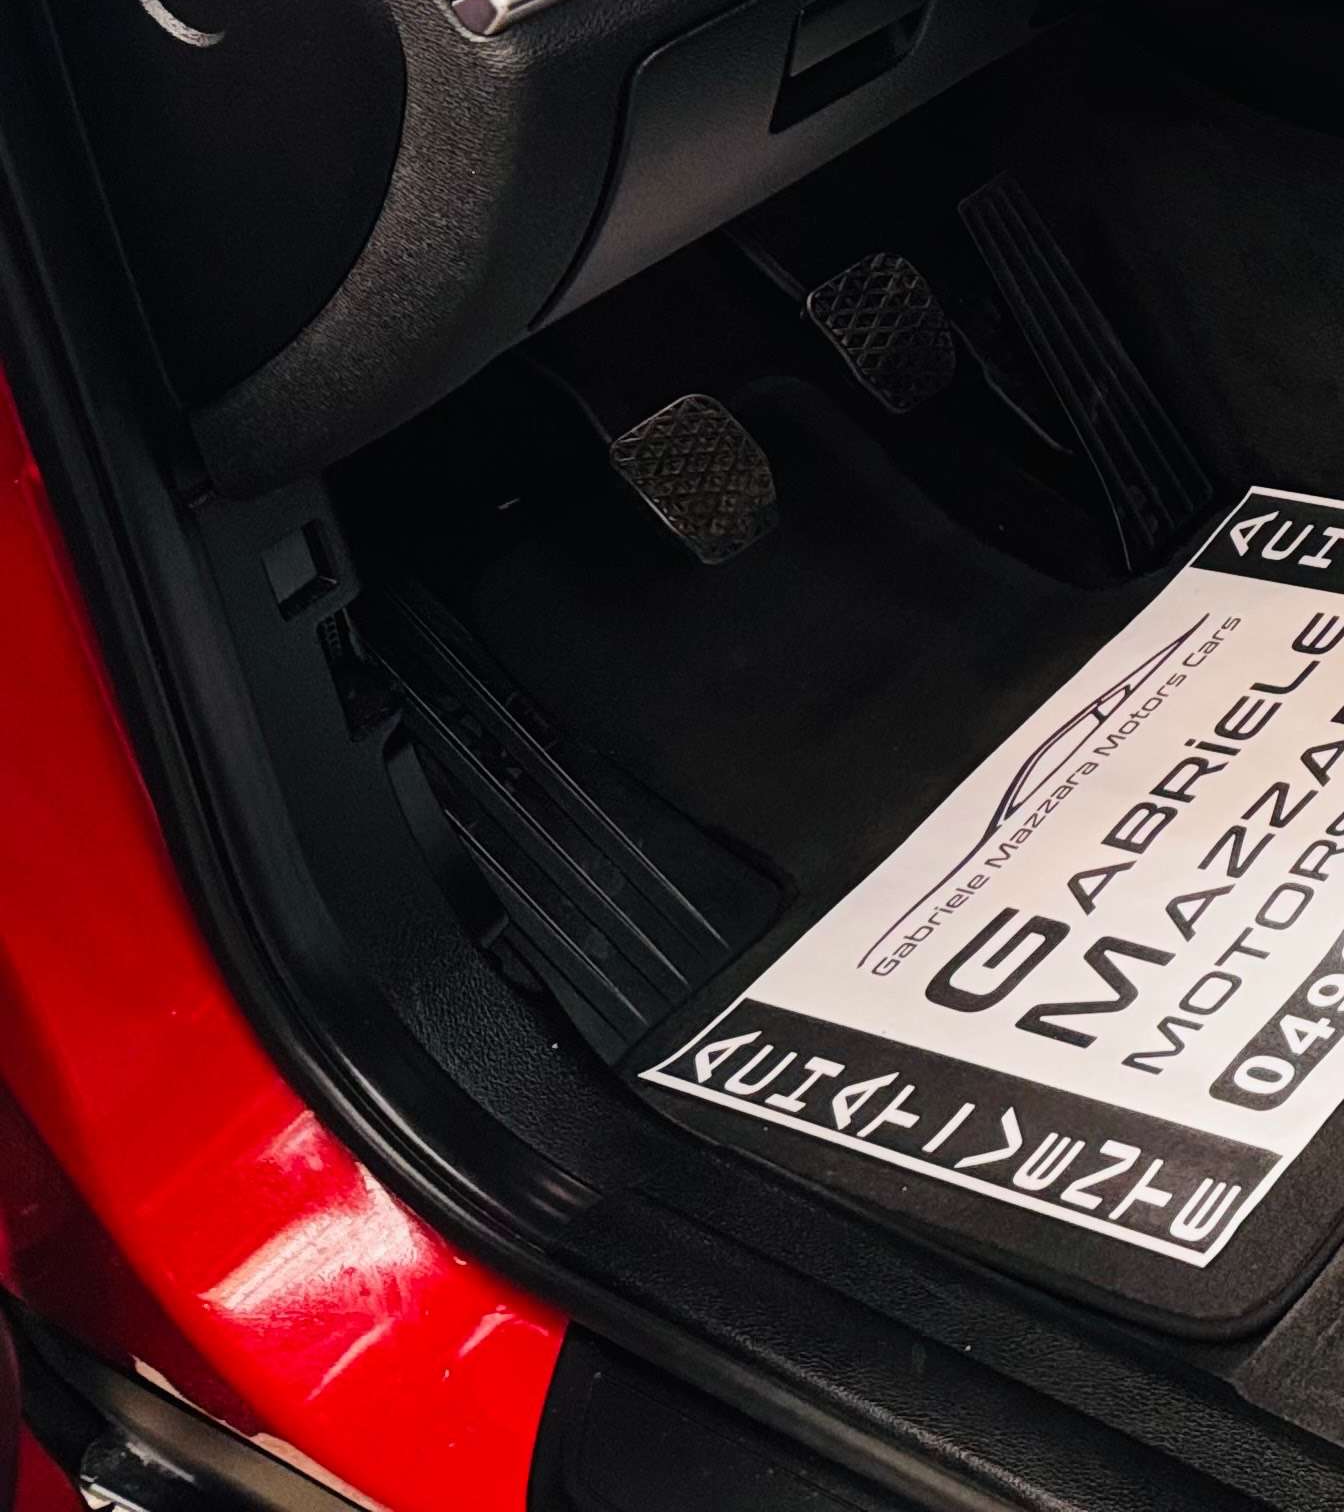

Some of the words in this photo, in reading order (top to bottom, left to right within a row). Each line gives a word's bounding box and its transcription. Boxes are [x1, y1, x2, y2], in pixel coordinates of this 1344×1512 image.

[872, 873, 990, 976] Gabriele
[985, 761, 1099, 868] Mazzara
[1094, 674, 1187, 756] Motors
[1182, 616, 1241, 668] Cars
